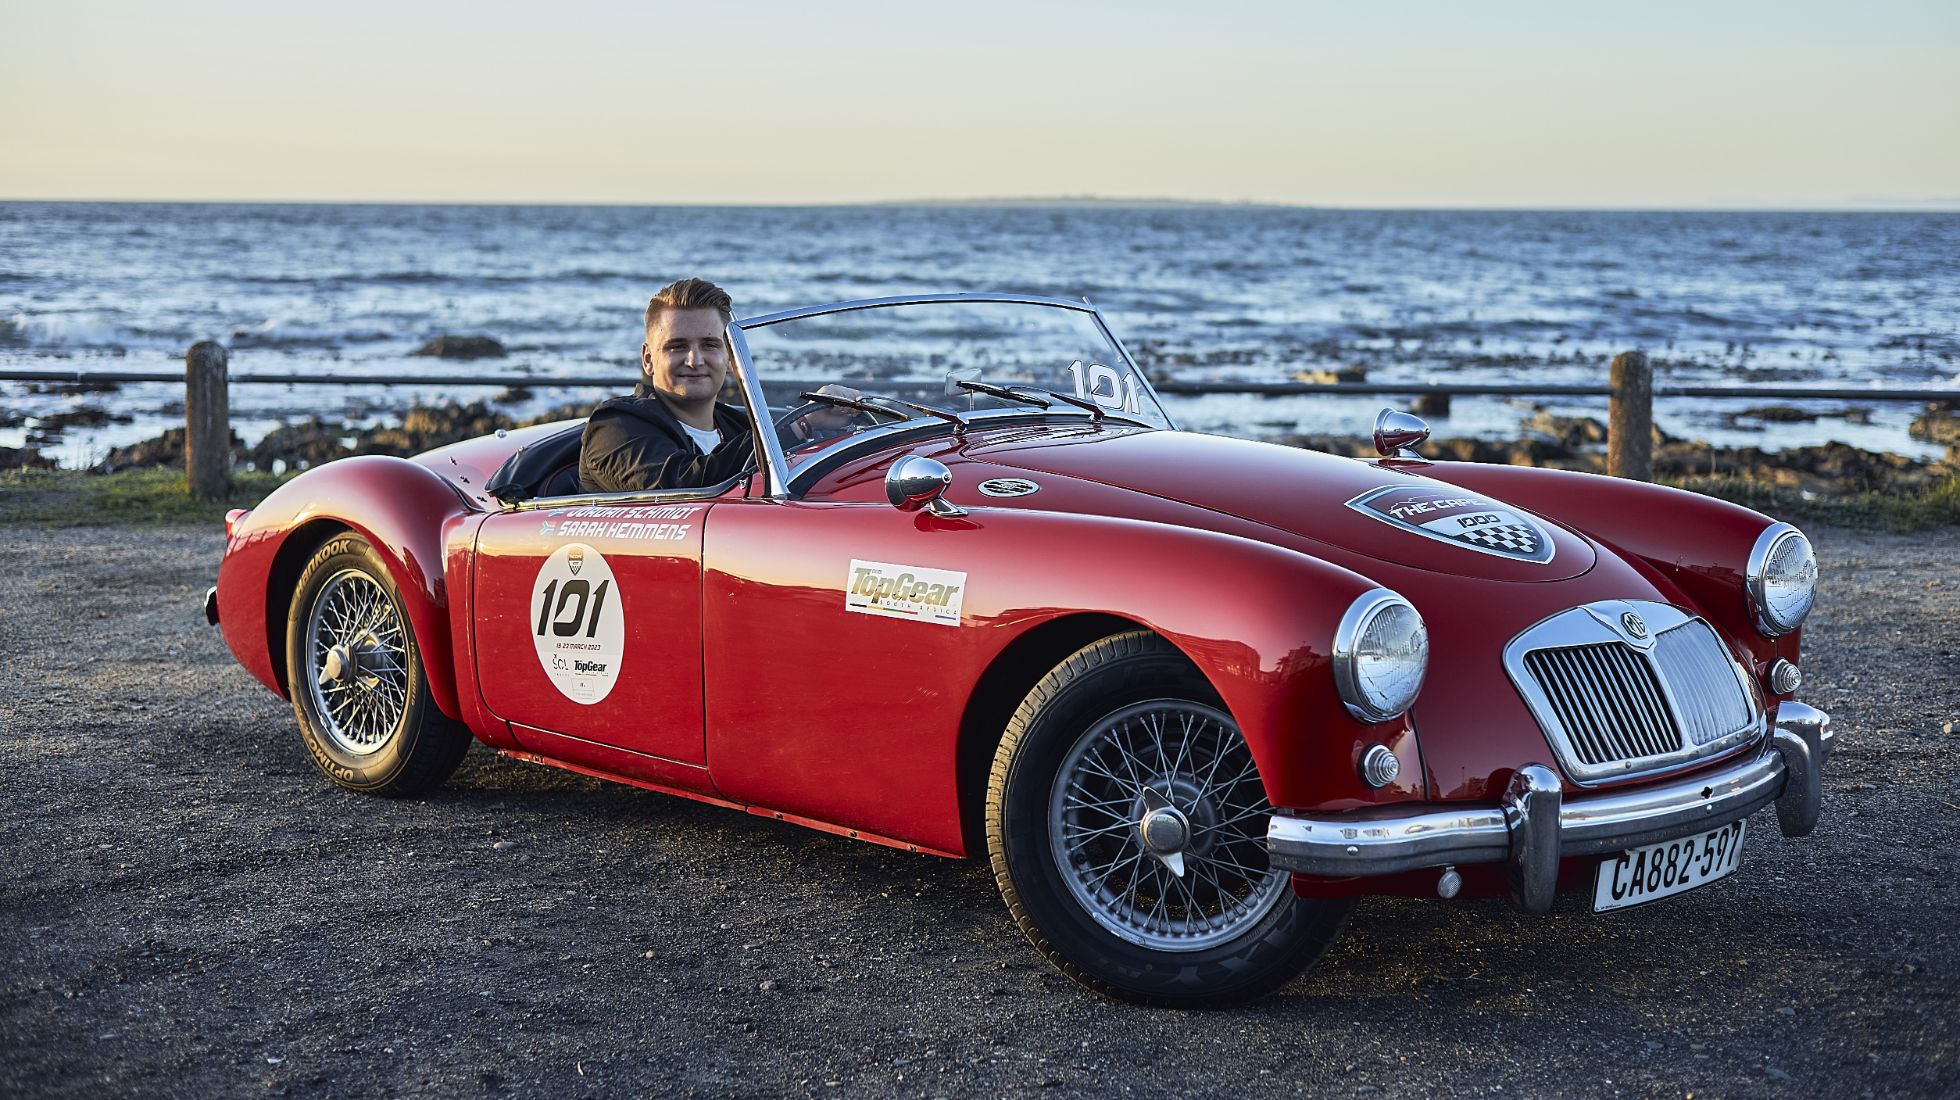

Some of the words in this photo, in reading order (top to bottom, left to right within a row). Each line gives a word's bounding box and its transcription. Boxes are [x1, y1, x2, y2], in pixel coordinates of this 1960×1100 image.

[1067, 359, 1141, 415] 101
[624, 507, 703, 520] SCHMIDT
[1389, 501, 1437, 519] THE
[1434, 498, 1488, 510] CAPE
[557, 520, 607, 537] SARAH
[606, 522, 692, 541] HEMMENS
[1456, 514, 1501, 529] 1000
[851, 567, 960, 607] TopGear
[536, 578, 610, 638] 101
[1625, 613, 1647, 635] MG
[574, 660, 608, 673] TopGear
[308, 737, 354, 782] OPTIMO
[1611, 821, 1742, 901] CA882-597
